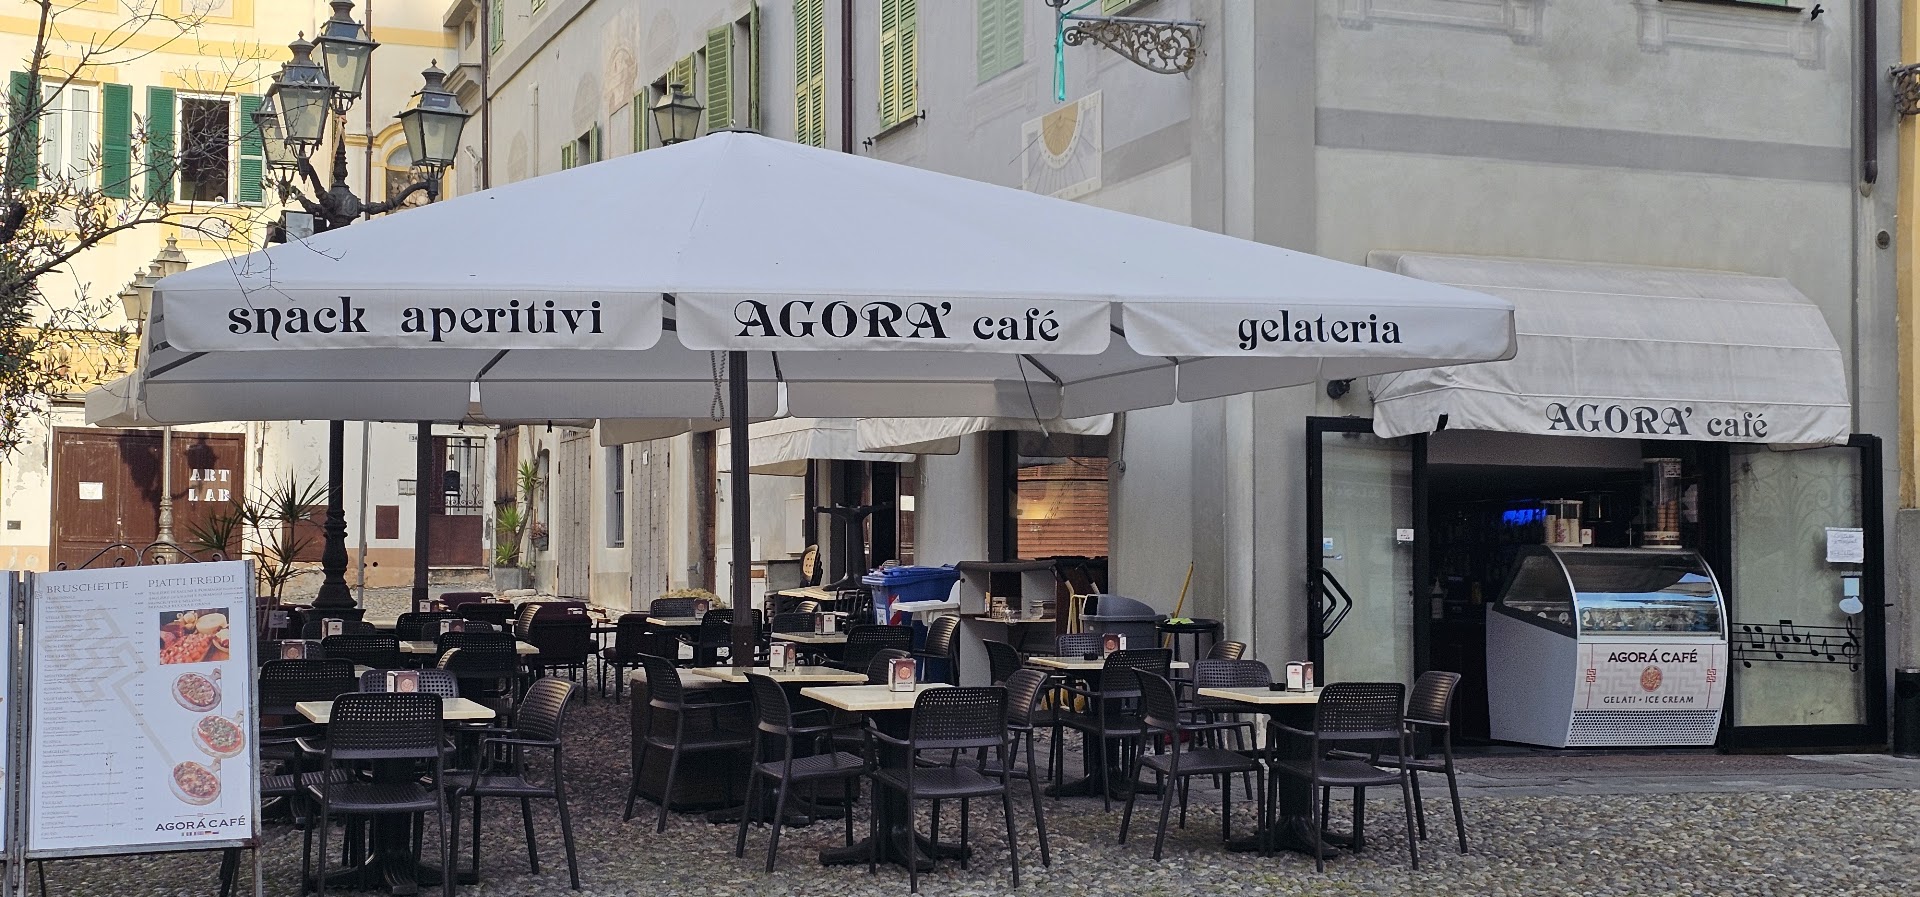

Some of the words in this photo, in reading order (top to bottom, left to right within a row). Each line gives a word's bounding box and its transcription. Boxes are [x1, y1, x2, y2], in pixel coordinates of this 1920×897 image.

[227, 295, 370, 341] snack
[400, 299, 605, 343] aperitivi
[733, 299, 952, 339] AGORA'
[972, 307, 1060, 342] café
[1238, 309, 1403, 351] gelateria
[1545, 402, 1693, 436] AGORA'
[1706, 411, 1768, 438] café
[189, 468, 230, 482] ART
[188, 488, 230, 502] LAB
[46, 580, 129, 594] BRUSCHETTE
[148, 577, 186, 588] PIATTI
[190, 574, 235, 585] FREDDI
[1607, 648, 1659, 663] AGORÁ
[1660, 648, 1698, 663] CAFÉ
[1603, 696, 1636, 704] GELATI
[1644, 695, 1659, 703] ICE
[154, 817, 206, 832] AGORÁ
[208, 814, 246, 828] CAFÉ
